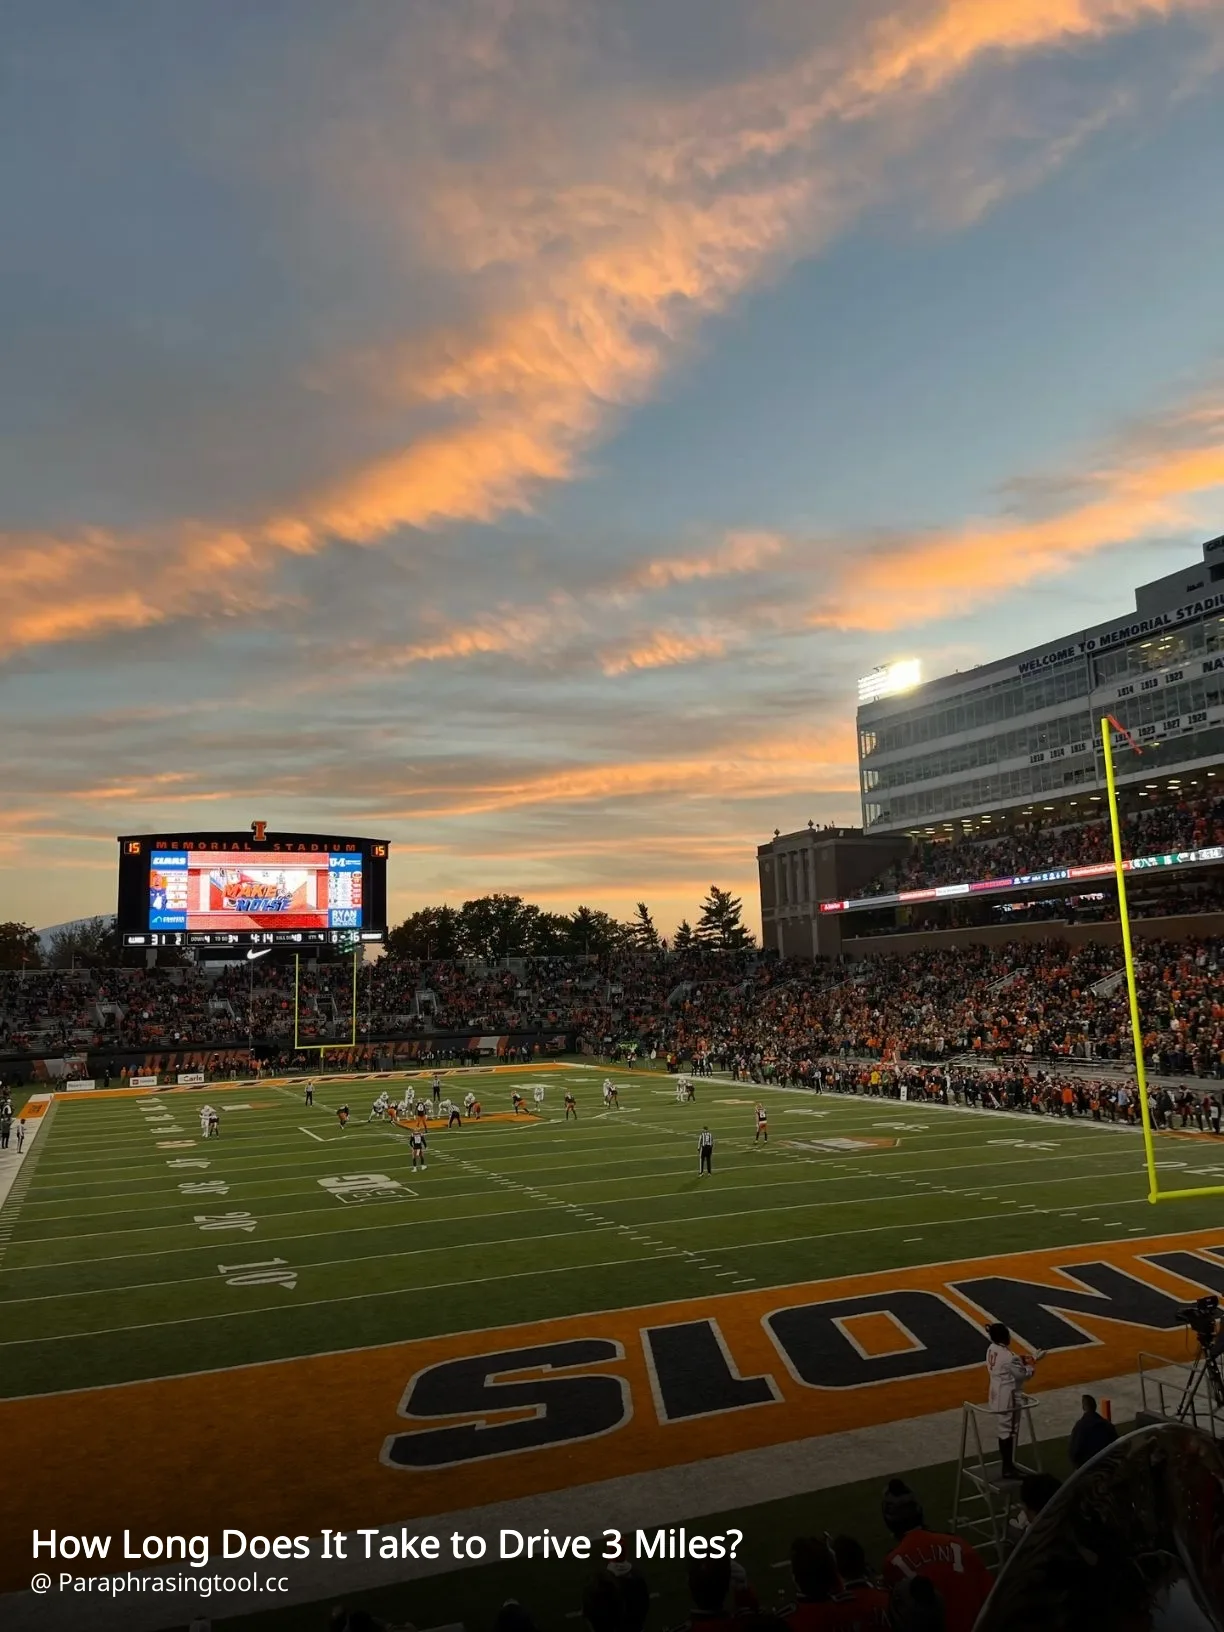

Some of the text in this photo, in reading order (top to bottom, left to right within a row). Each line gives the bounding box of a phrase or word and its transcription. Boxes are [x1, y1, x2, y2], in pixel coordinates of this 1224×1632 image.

[1019, 646, 1075, 674] WELCOME
[1078, 640, 1095, 653] TO
[1100, 614, 1172, 646] MEMORIAL
[129, 842, 140, 853] 15
[156, 841, 356, 852] MEMORIAL STADIUM
[375, 846, 385, 856] 15
[222, 883, 277, 898] MAKE
[236, 897, 292, 911] NOISE
[250, 933, 273, 943] 4:14
[183, 1075, 203, 1083] Carle
[193, 1211, 258, 1231] 20
[217, 1257, 298, 1287] 10
